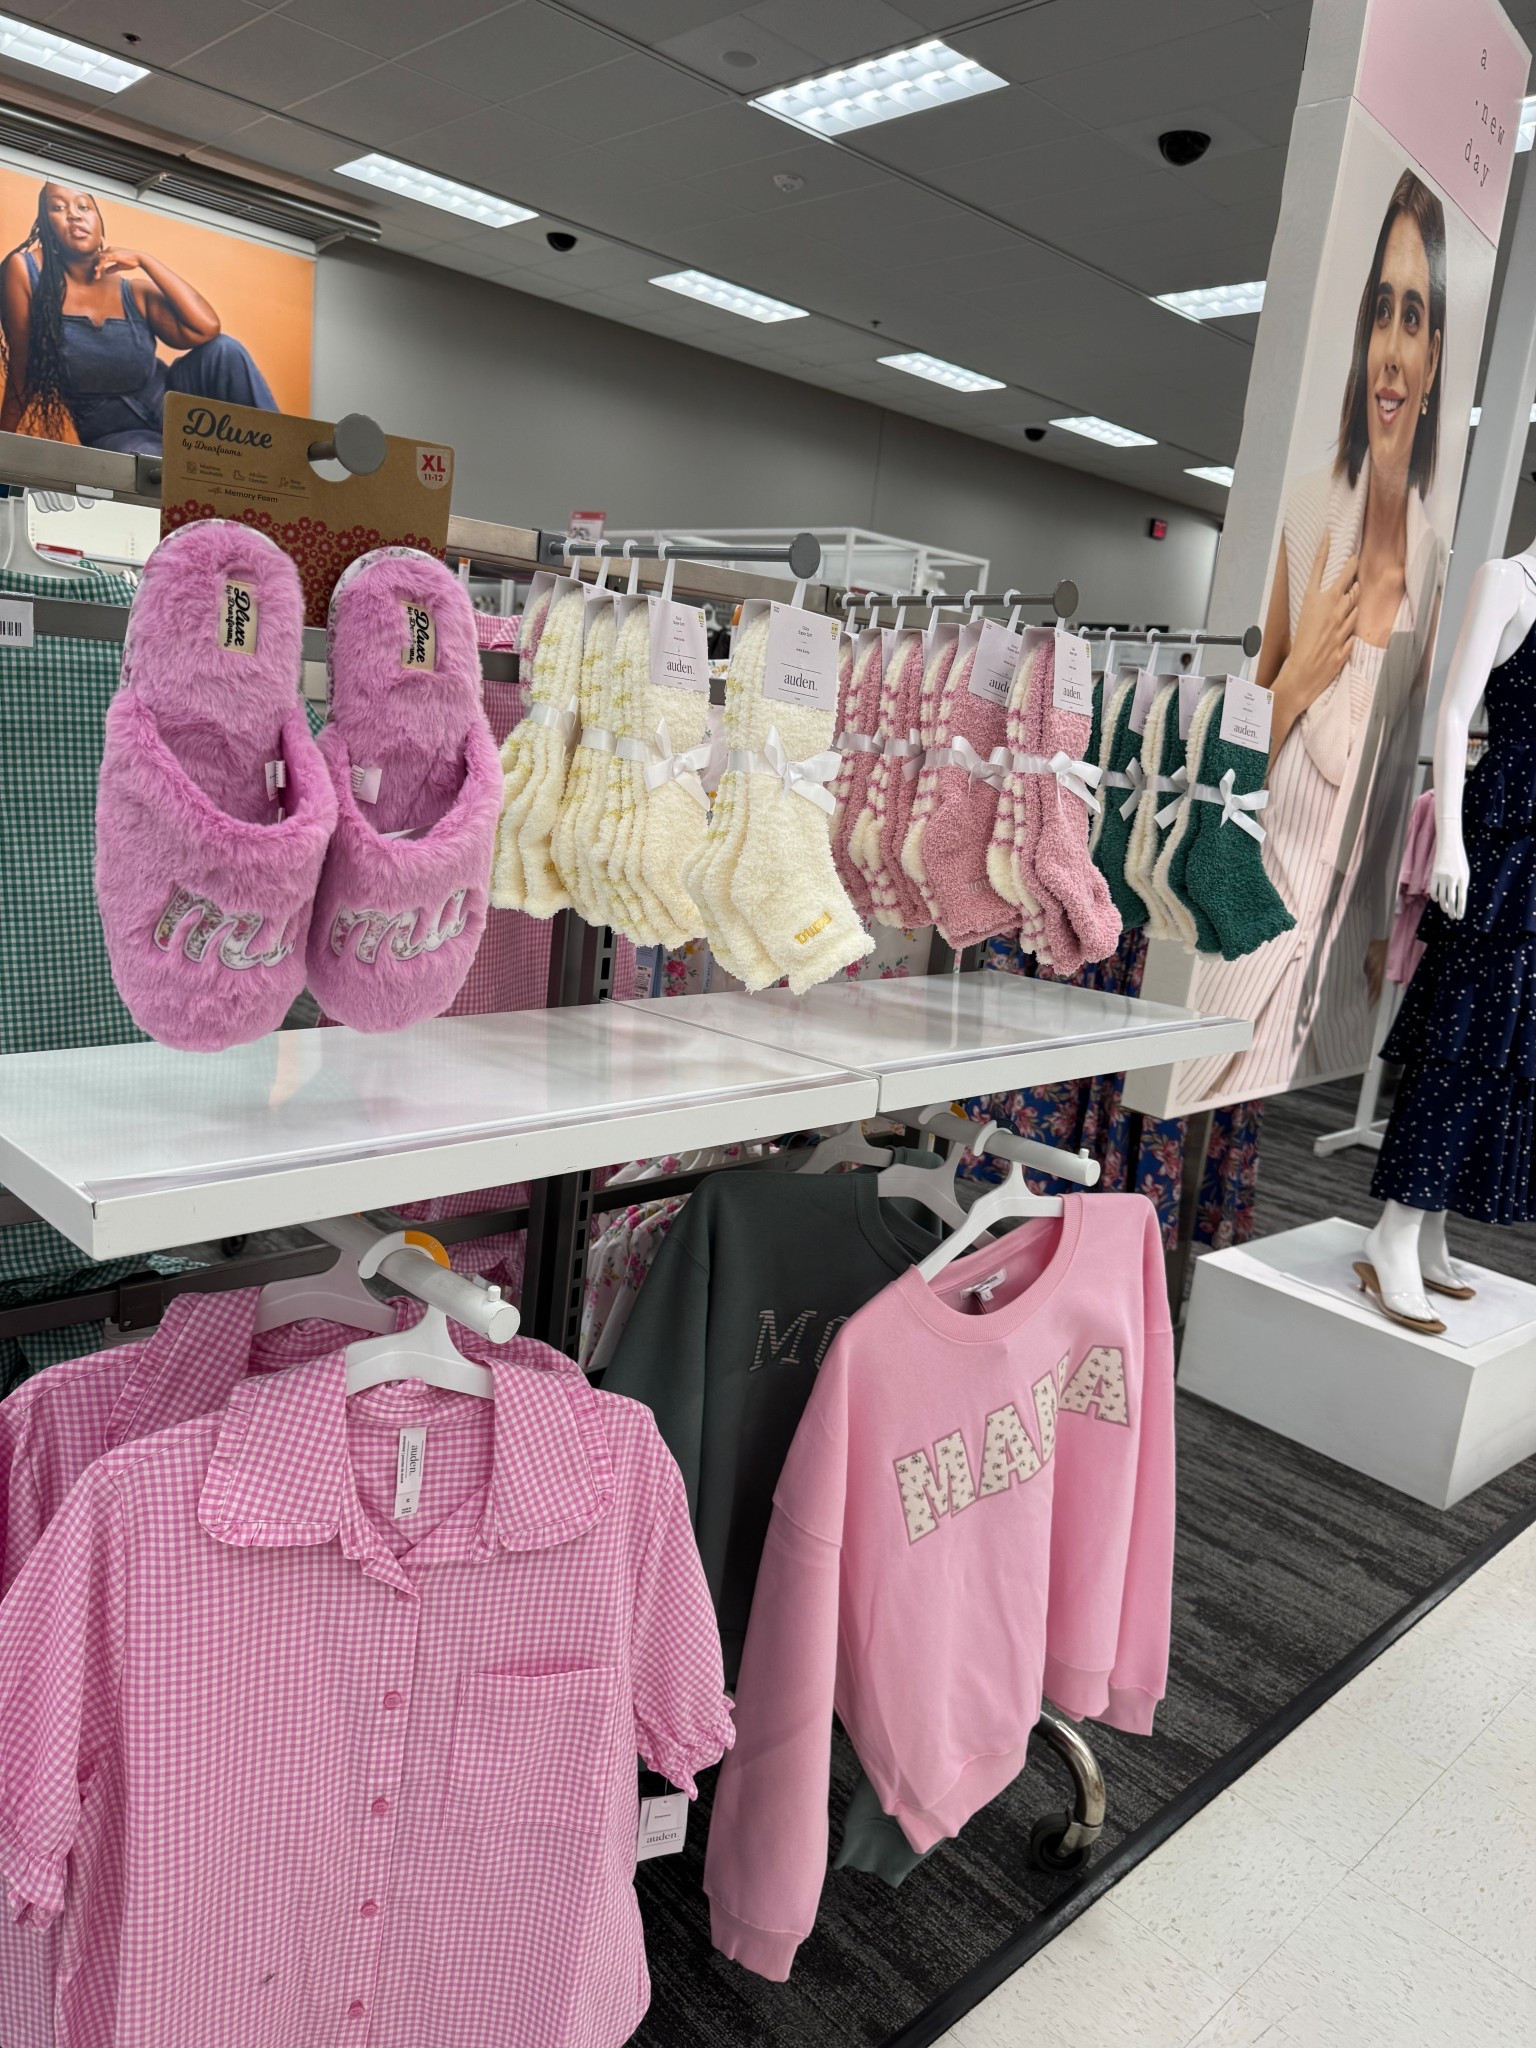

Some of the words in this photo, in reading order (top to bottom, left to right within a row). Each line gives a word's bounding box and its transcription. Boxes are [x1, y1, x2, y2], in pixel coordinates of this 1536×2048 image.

[1480, 49, 1488, 70] a
[1464, 138, 1490, 188] day
[182, 407, 273, 449] Dluxe
[182, 438, 193, 450] by
[421, 454, 446, 473] XL
[424, 473, 443, 482] 11-12
[224, 488, 256, 501] Memory
[257, 494, 278, 503] Foam
[234, 587, 251, 647] Dluxe
[414, 608, 430, 663] Dluxe
